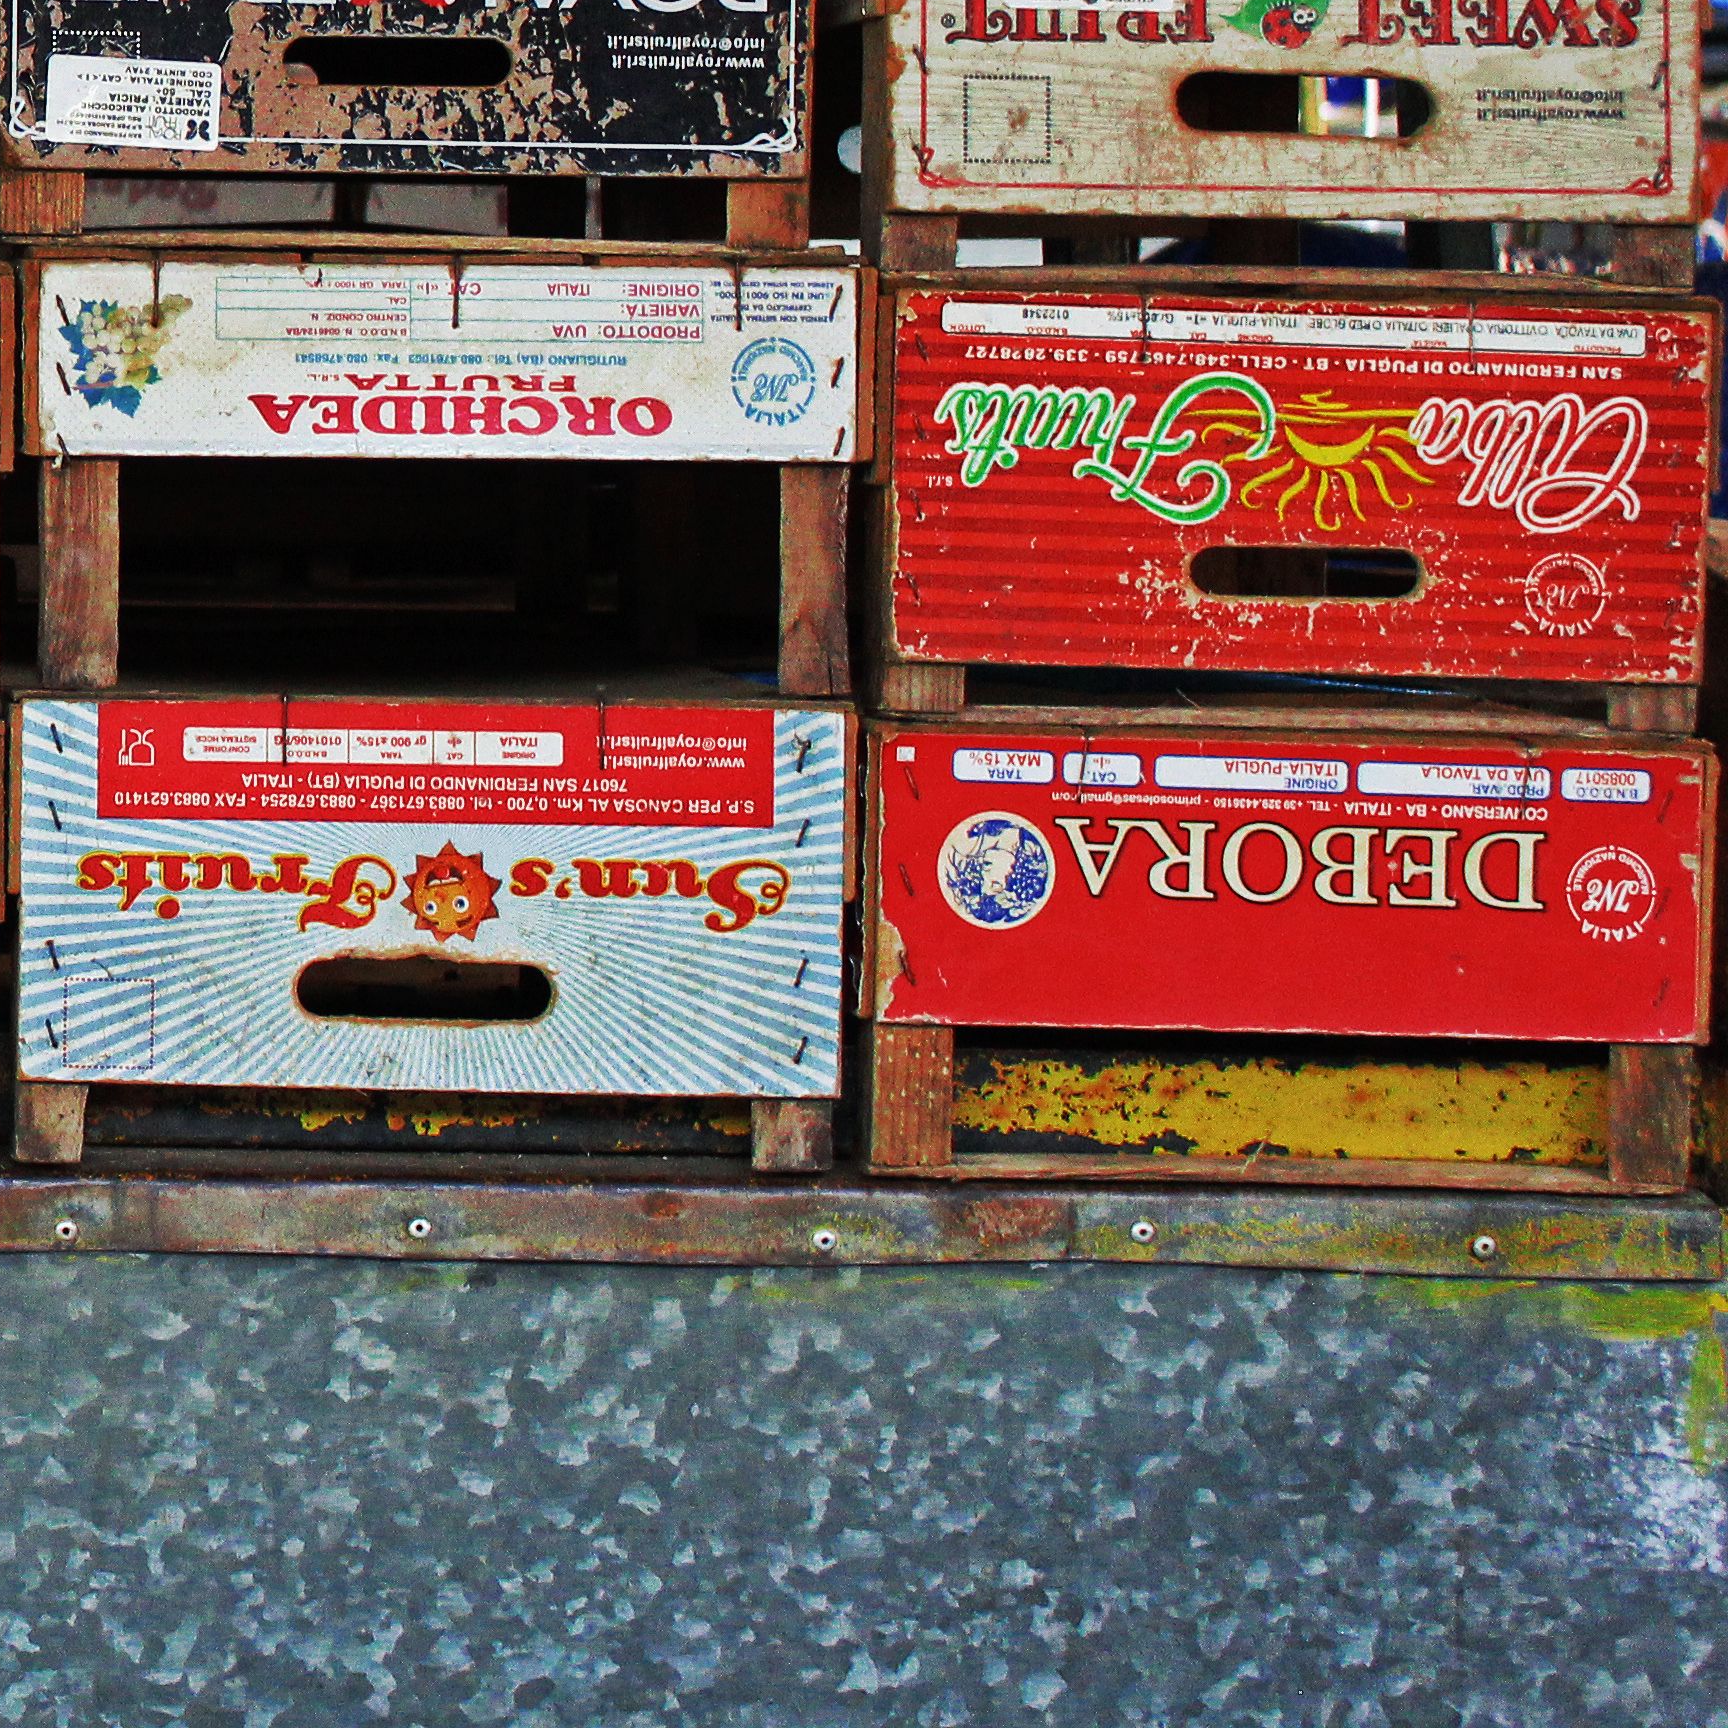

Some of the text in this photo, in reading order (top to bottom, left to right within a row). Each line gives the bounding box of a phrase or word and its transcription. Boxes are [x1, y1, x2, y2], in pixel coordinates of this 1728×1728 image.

[607, 34, 765, 50] info@royalfruitsrl.it
[611, 54, 765, 69] www.royalfruitsrl.it
[108, 93, 148, 103] PRICIA
[155, 106, 210, 116] PRODOTTO
[547, 282, 700, 297] ORIGINE: ITALIA
[552, 325, 701, 339] PRODOTTO: UVA
[1344, 356, 1622, 379] SAN PUGLIA
[344, 374, 576, 392] FRUTTA
[248, 395, 673, 436] ORCHIDEA
[932, 372, 1276, 525] Fruits
[969, 751, 1041, 766] MAX 15%
[987, 768, 1021, 780] TARA
[1224, 760, 1338, 776] ITALIA-PUGLIA
[1421, 766, 1508, 781] DA TAVOLA
[241, 773, 627, 792] 76017 SAN FERDINANDO PUGLIA ITALIA
[1284, 777, 1338, 790] ORIGINE
[1576, 771, 1636, 785] 0085017
[114, 791, 721, 813] PER CANOSA AL 0,700 0883.678254 FAX 0883.621410
[1343, 801, 1427, 817] BA ITALIA
[1053, 816, 1548, 912] DEBORA
[74, 849, 791, 932] Sun's Fruits
[1580, 919, 1643, 942] ITALIA
